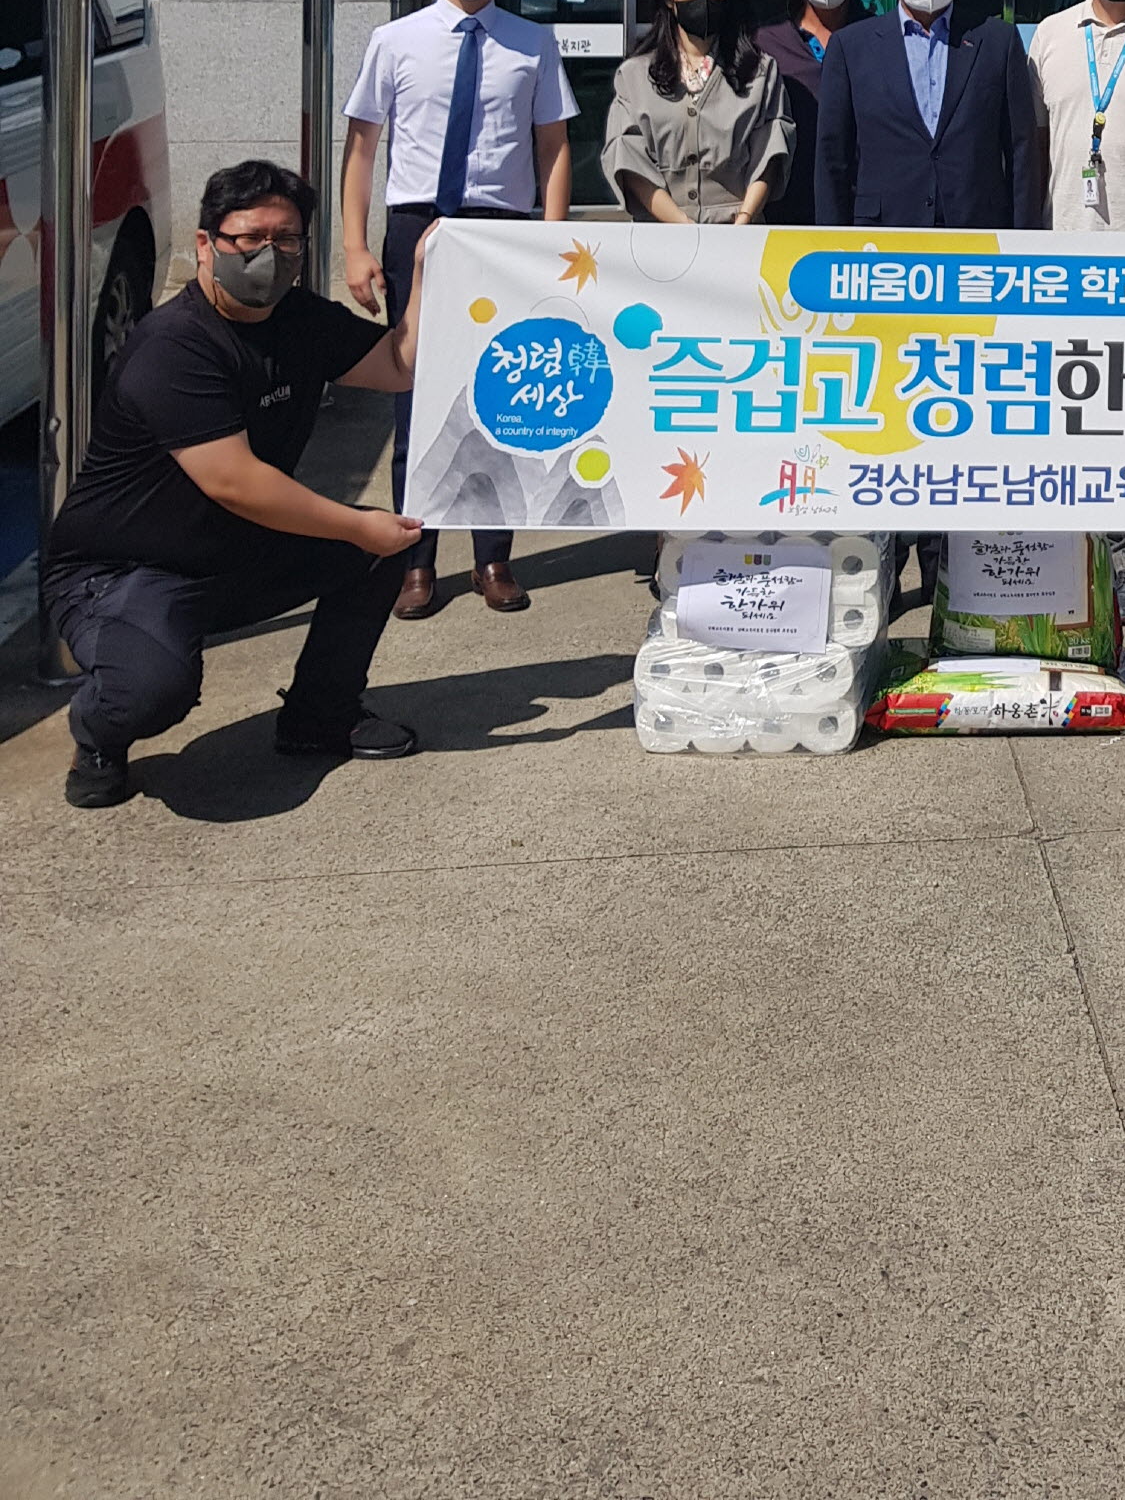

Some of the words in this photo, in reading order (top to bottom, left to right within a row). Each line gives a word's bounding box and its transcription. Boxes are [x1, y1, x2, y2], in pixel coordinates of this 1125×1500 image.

[556, 39, 592, 53] 복지관
[830, 263, 945, 303] 배움이
[957, 265, 1070, 304] 즐거운
[649, 336, 879, 434] 즐겁고
[510, 380, 584, 417] 세상
[495, 428, 501, 436] a
[502, 427, 533, 438] country
[535, 426, 544, 436] of
[545, 426, 578, 438] integrity
[993, 556, 1030, 565] 가득한
[982, 564, 1040, 579] 한가위
[736, 587, 775, 598] 가득한
[720, 595, 785, 612] 한가위
